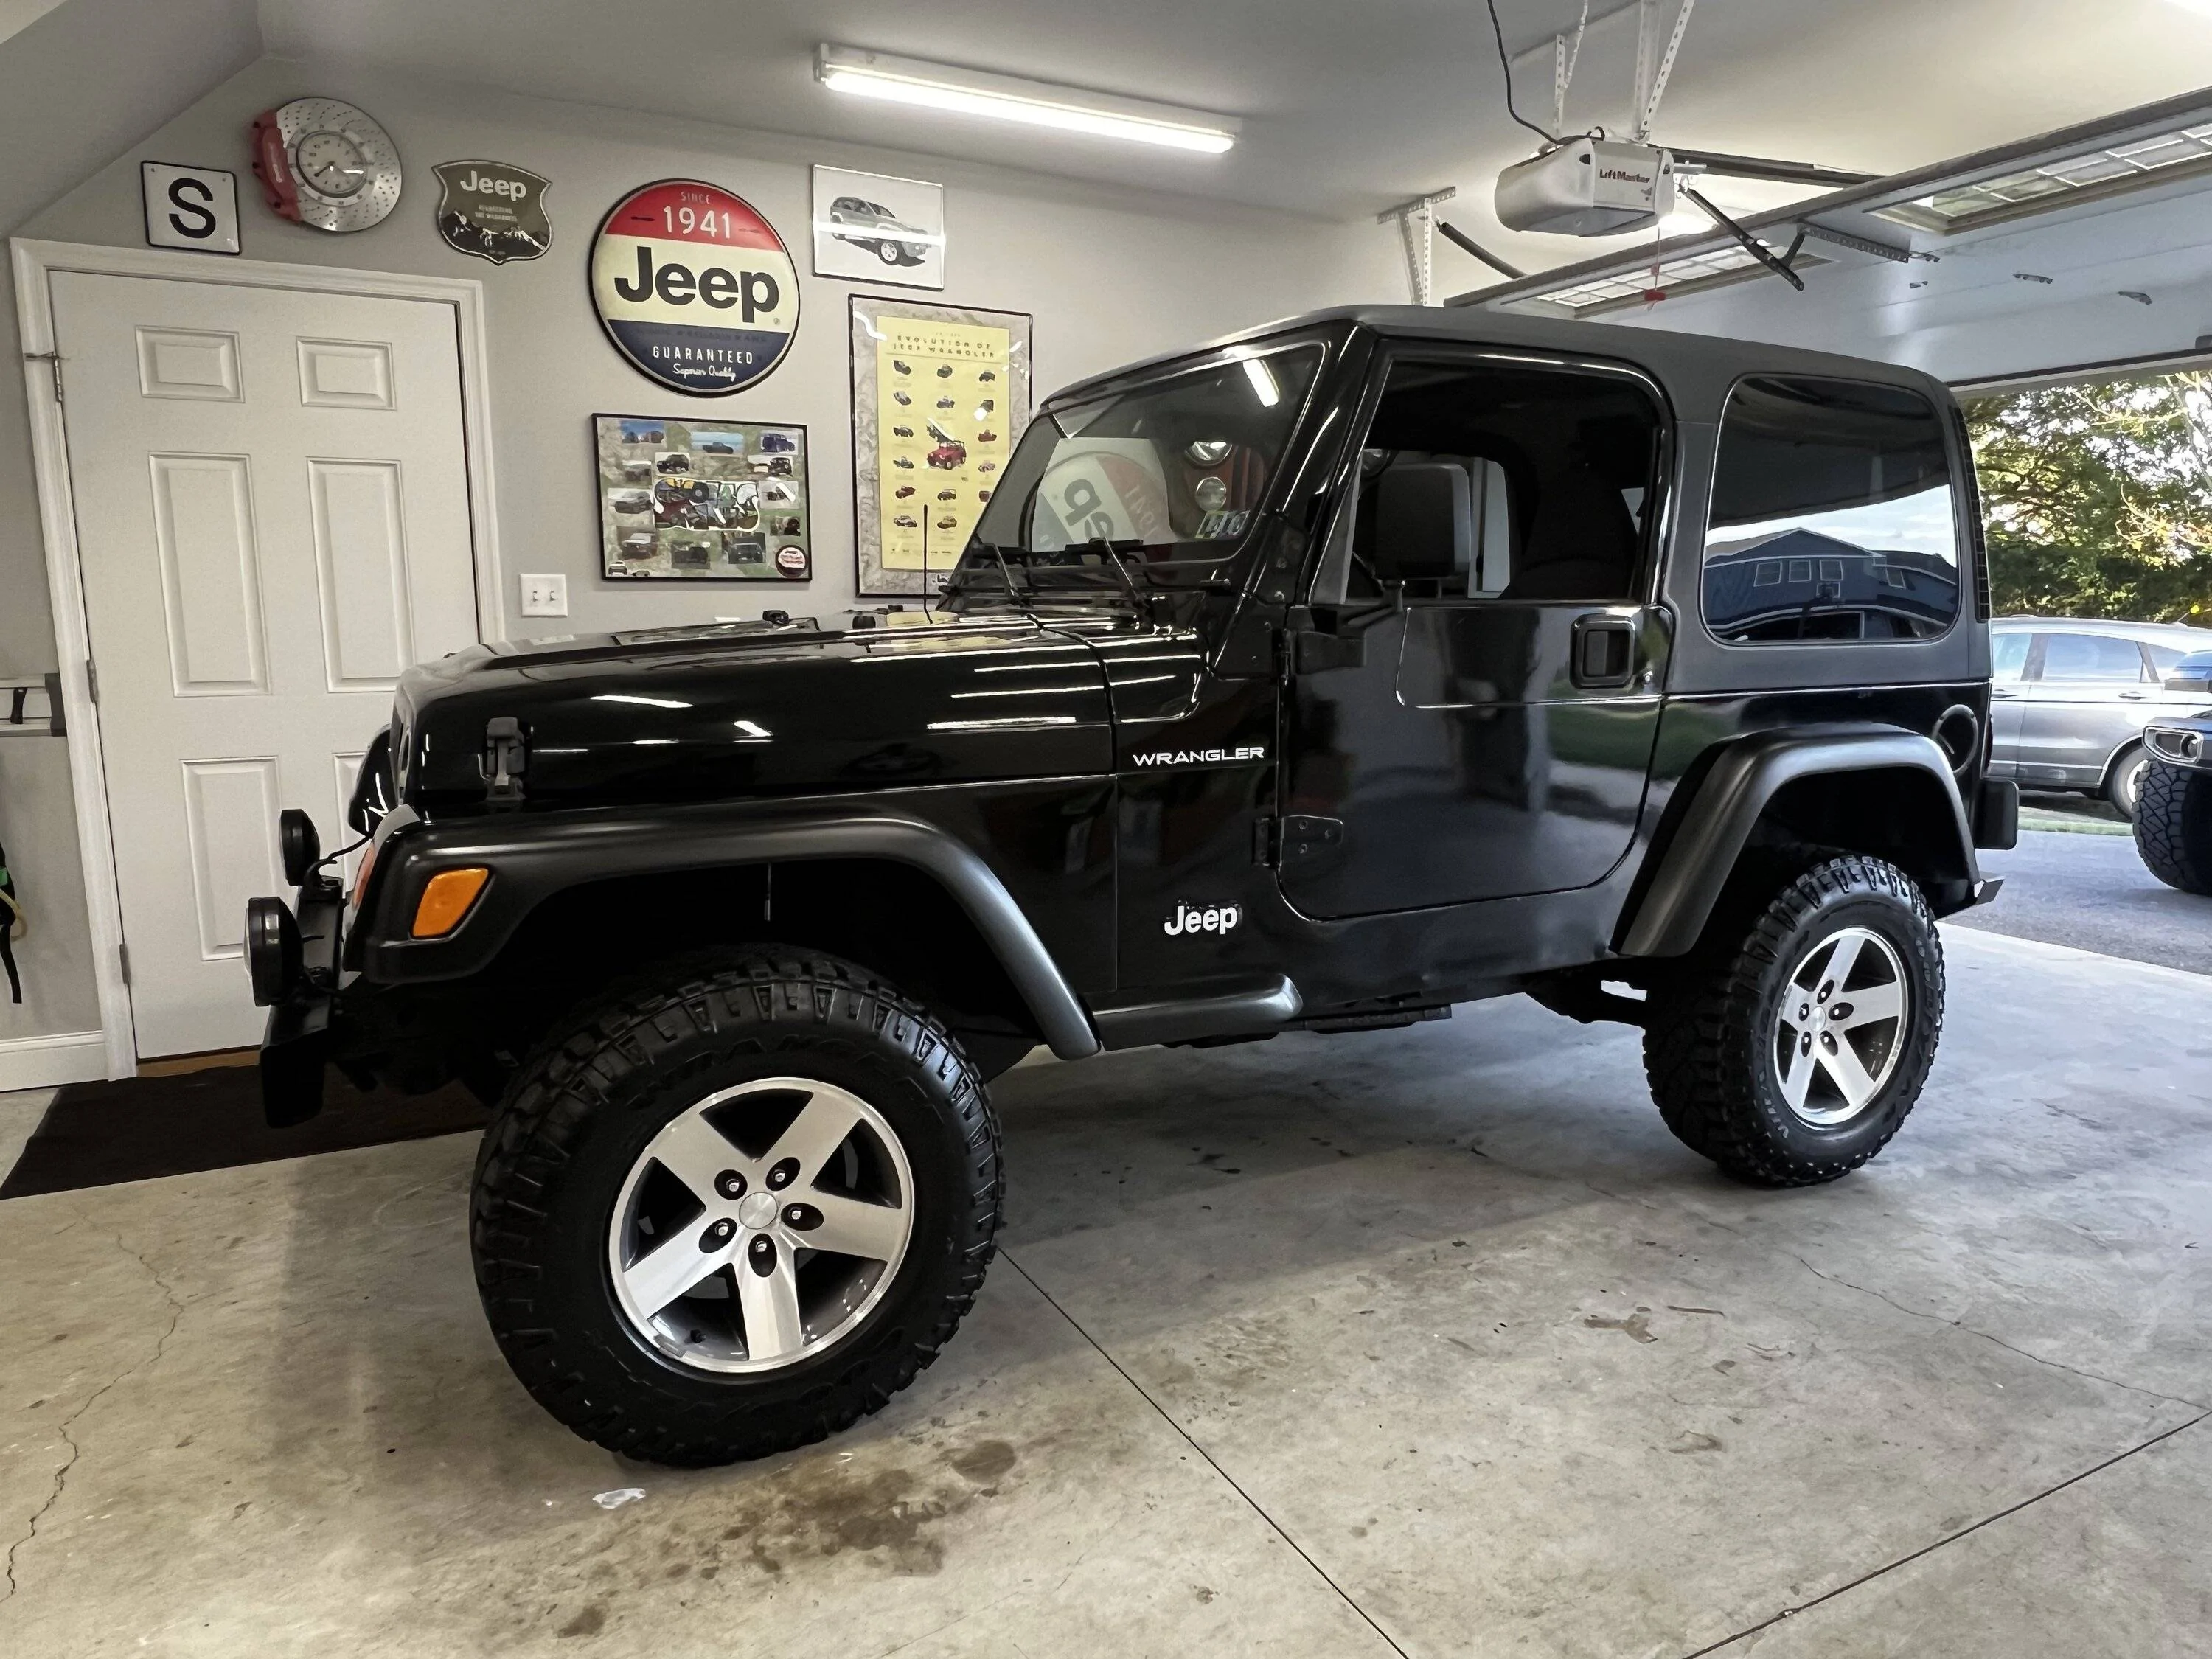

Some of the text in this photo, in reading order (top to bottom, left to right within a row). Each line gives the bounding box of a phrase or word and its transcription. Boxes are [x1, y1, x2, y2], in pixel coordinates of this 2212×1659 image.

[460, 170, 526, 201] Jeep
[1599, 168, 1651, 184] LiftMaster
[168, 178, 217, 239] S
[681, 191, 711, 205] SINCE
[664, 205, 731, 239] 1941
[614, 246, 779, 324] Jeep
[897, 335, 970, 347] EVOLUTION
[653, 346, 753, 364] GUARANTEED
[1132, 746, 1265, 766] WRANGLER
[1164, 905, 1238, 936] Jeep
